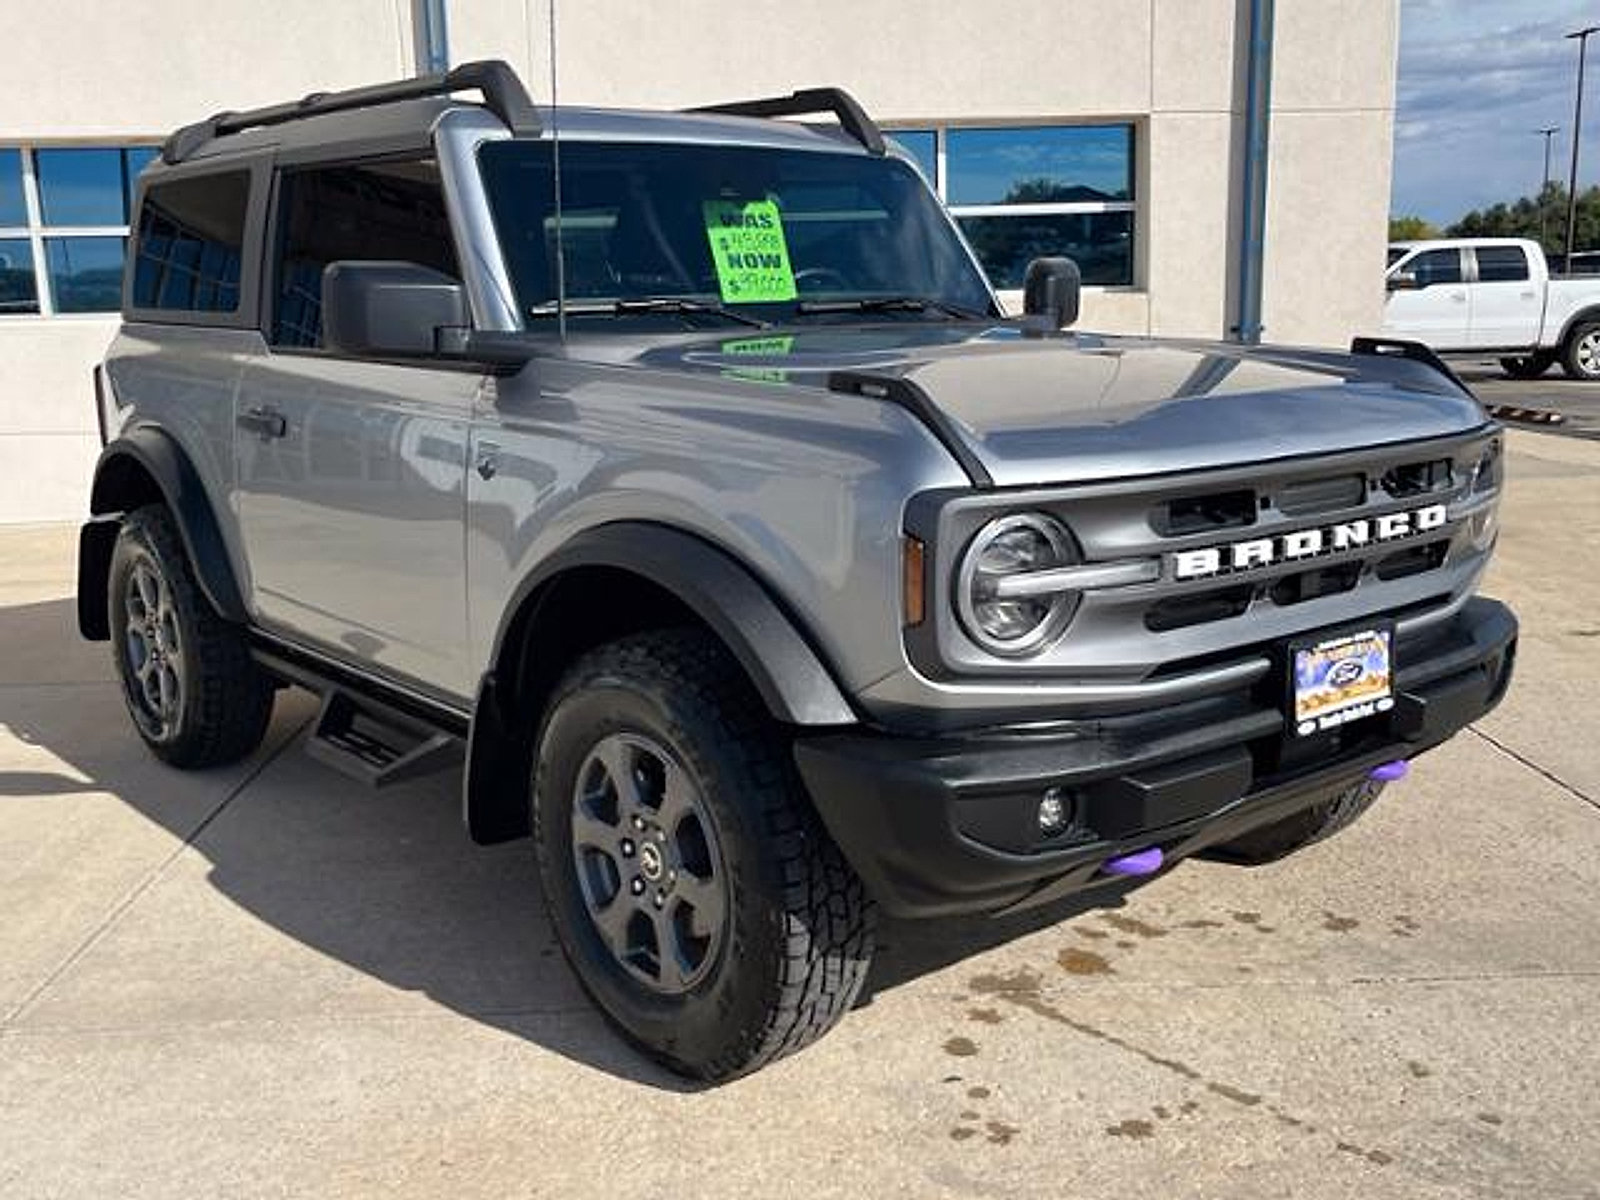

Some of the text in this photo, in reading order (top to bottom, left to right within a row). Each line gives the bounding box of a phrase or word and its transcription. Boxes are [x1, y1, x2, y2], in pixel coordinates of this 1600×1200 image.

[720, 213, 774, 229] WAS
[727, 253, 782, 269] NOW
[1175, 504, 1447, 578] BRONCO
